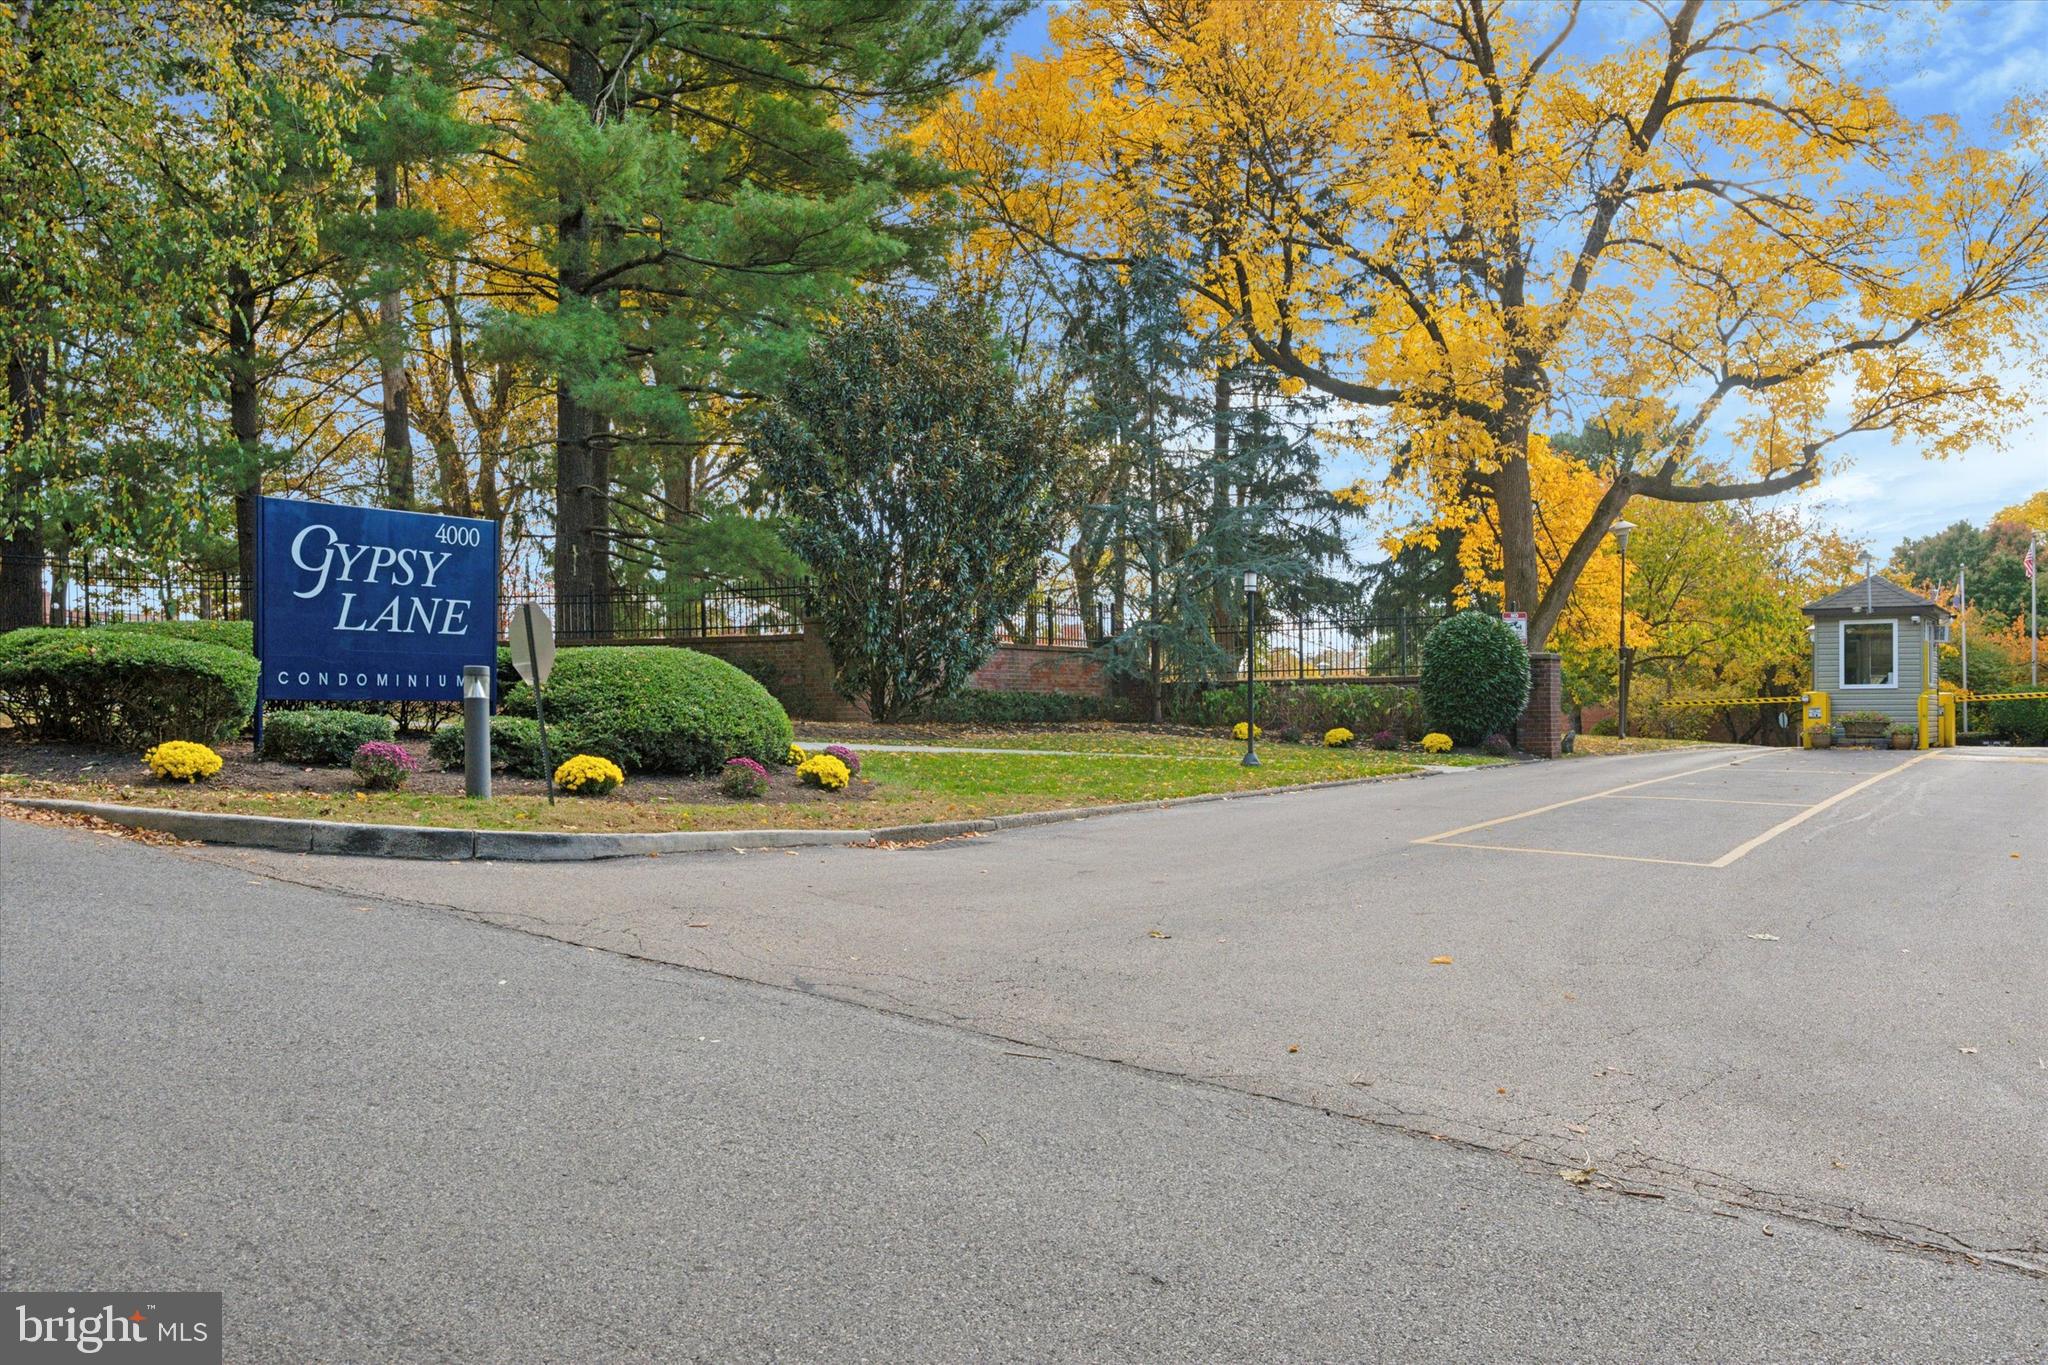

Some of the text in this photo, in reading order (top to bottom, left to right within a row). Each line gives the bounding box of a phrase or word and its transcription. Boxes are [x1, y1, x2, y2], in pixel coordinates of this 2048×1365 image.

[434, 523, 480, 547] 4000
[291, 524, 452, 599] GYPSY
[333, 593, 471, 635] LANE
[278, 671, 464, 688] CONDOMINIUM
